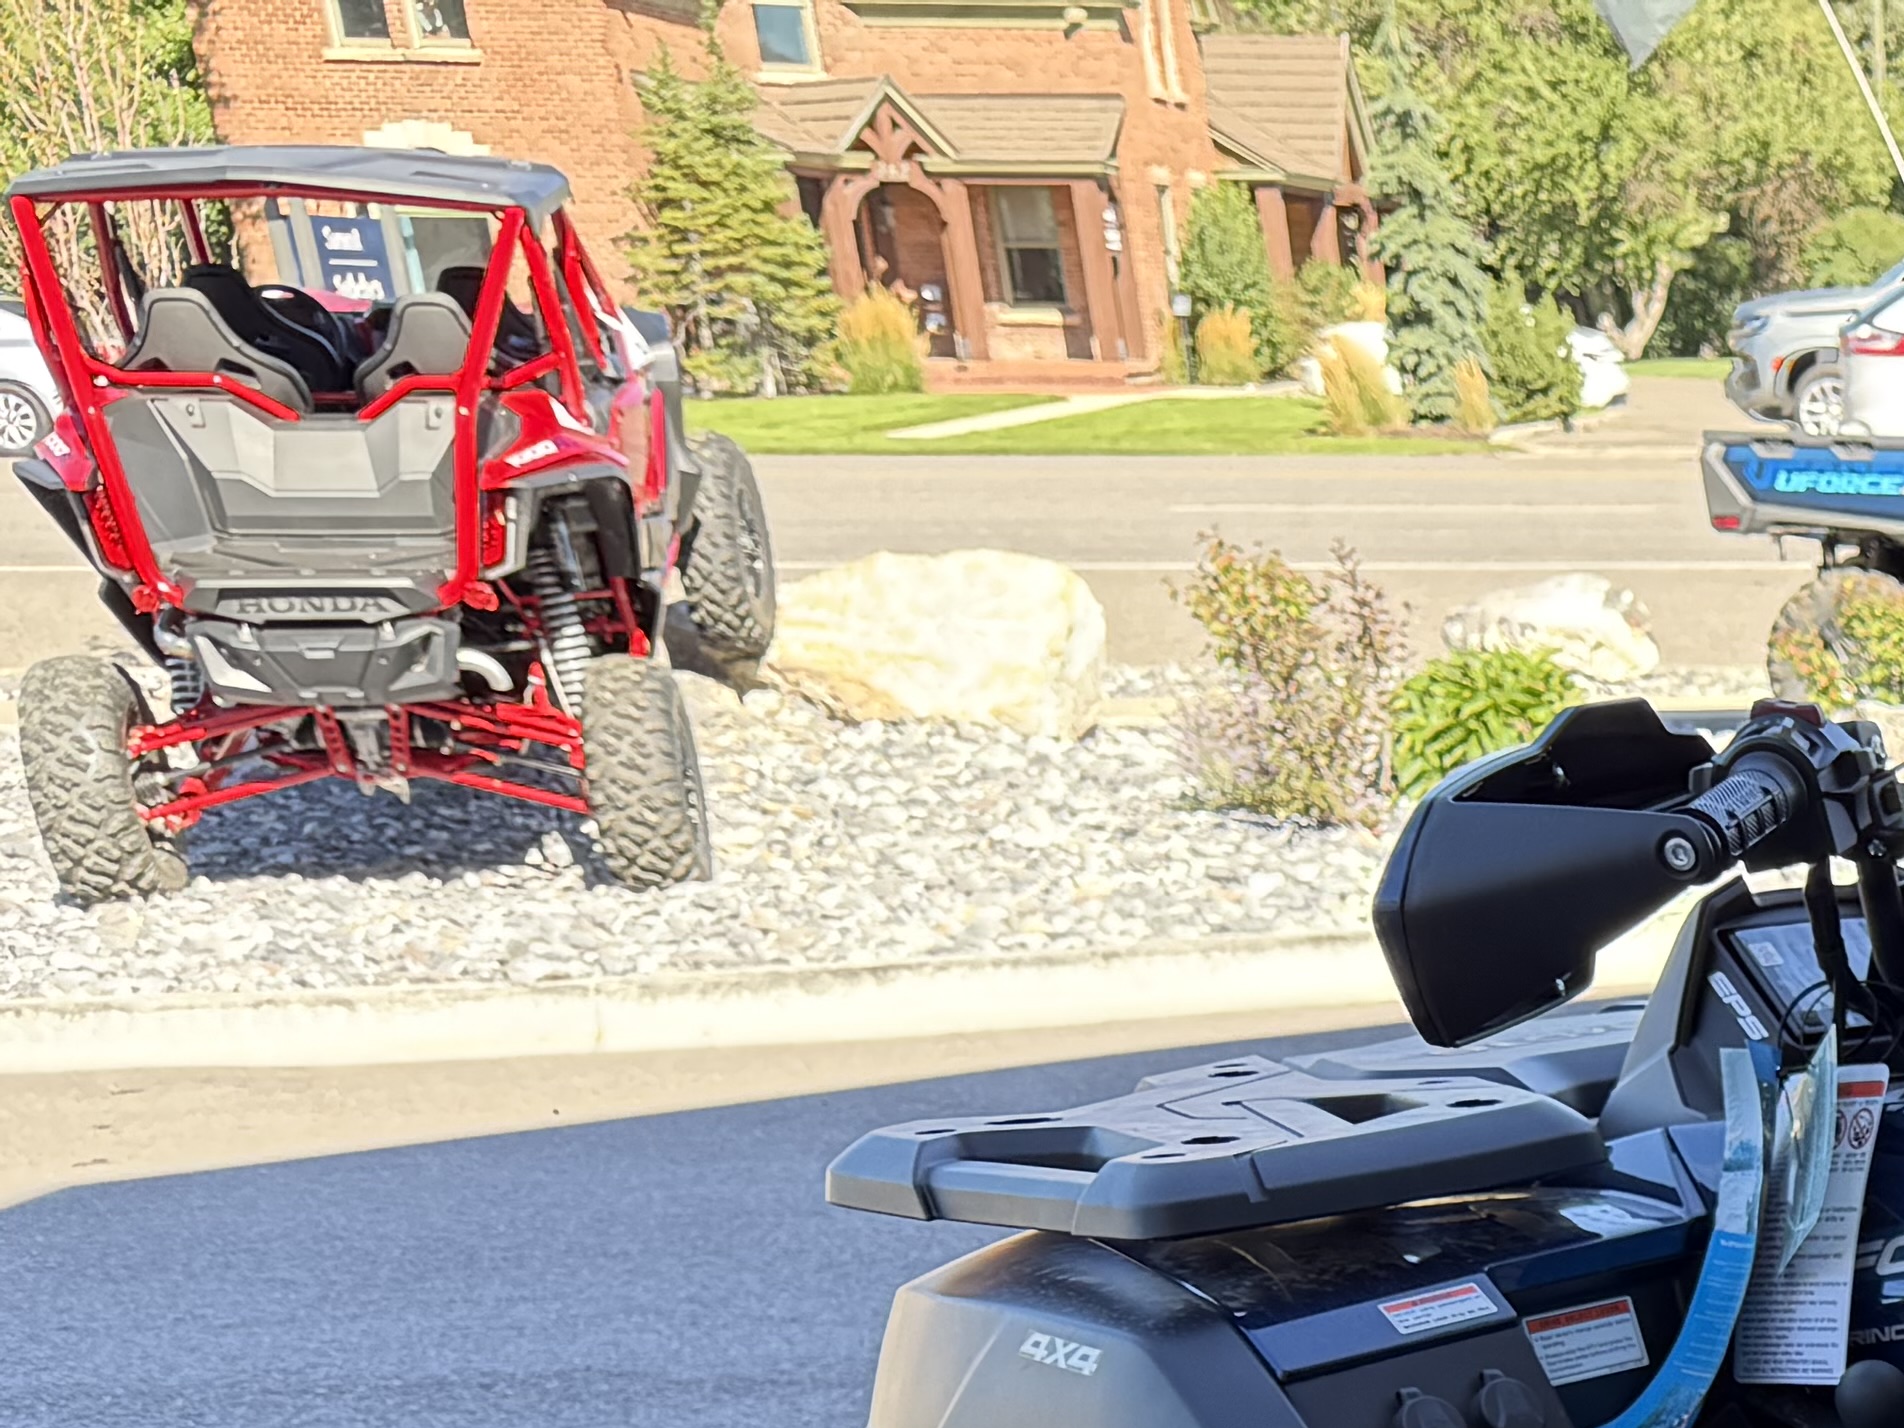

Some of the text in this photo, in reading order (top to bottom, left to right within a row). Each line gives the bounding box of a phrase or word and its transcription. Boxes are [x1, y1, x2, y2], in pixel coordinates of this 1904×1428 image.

[1773, 468, 1904, 496] UFORCE
[236, 596, 391, 614] HONDA
[1706, 970, 1770, 1041] EPS
